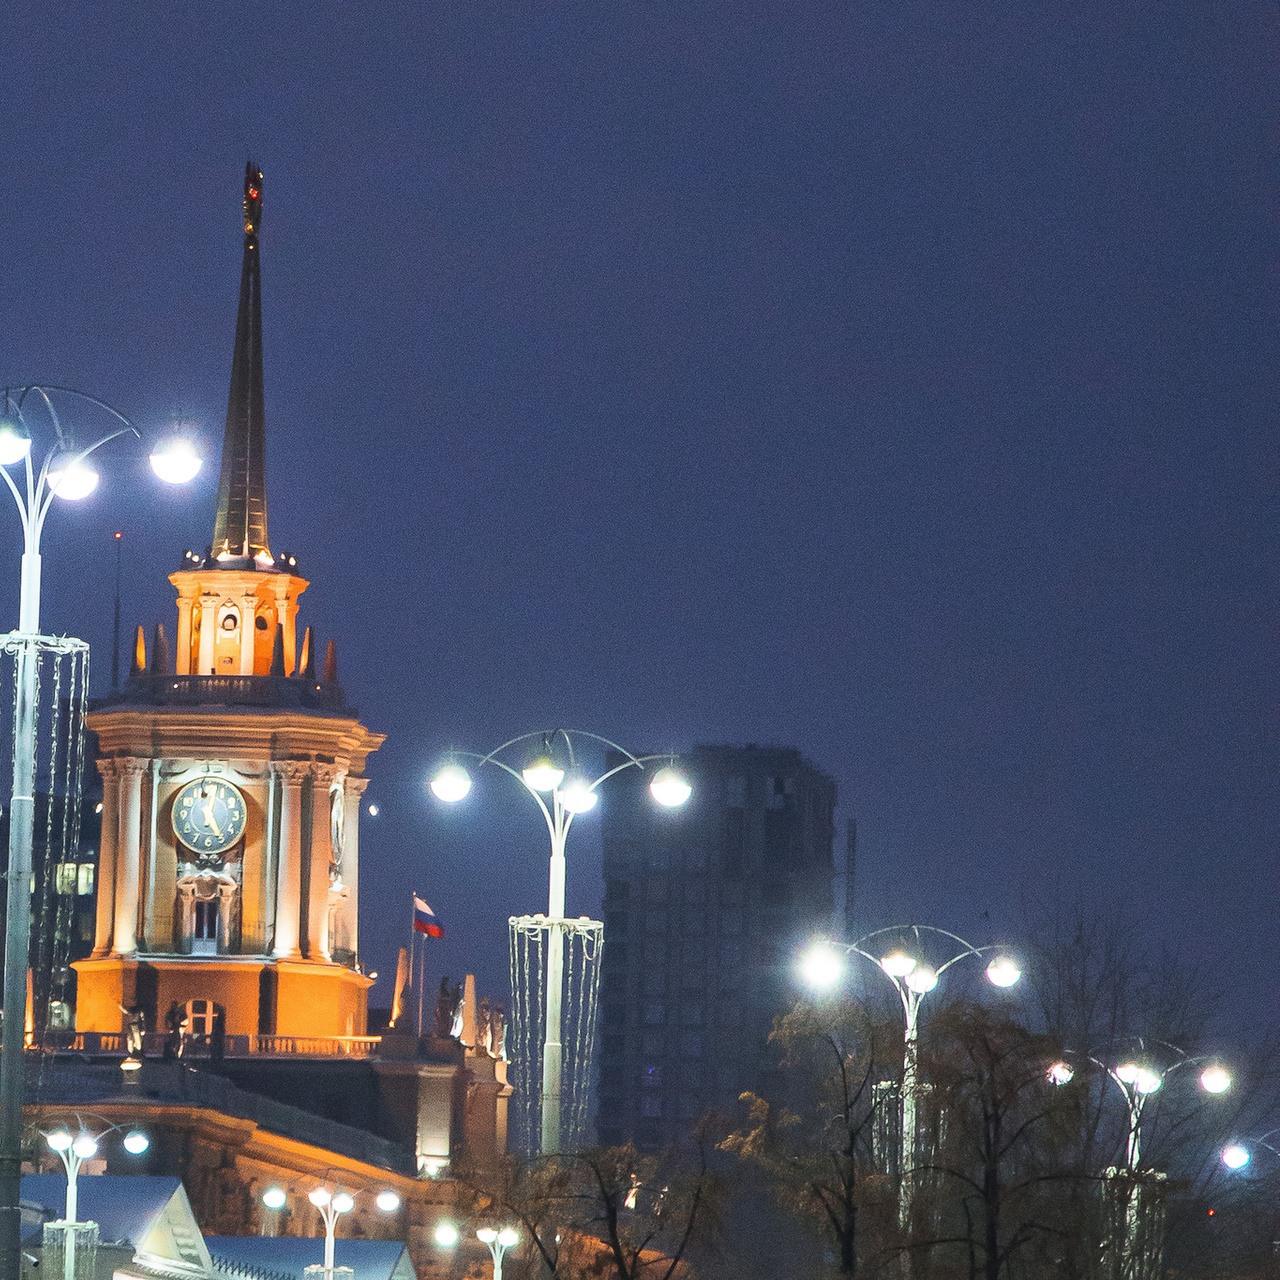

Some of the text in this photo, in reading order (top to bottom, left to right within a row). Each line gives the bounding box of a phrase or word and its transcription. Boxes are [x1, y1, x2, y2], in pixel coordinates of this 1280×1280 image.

[219, 787, 225, 799] 1
[180, 809, 188, 820] 9
[232, 810, 240, 821] 3
[183, 822, 191, 834] 8
[227, 822, 234, 835] 4
[192, 833, 200, 843] 7
[204, 836, 212, 847] 6
[218, 833, 225, 844] 5
